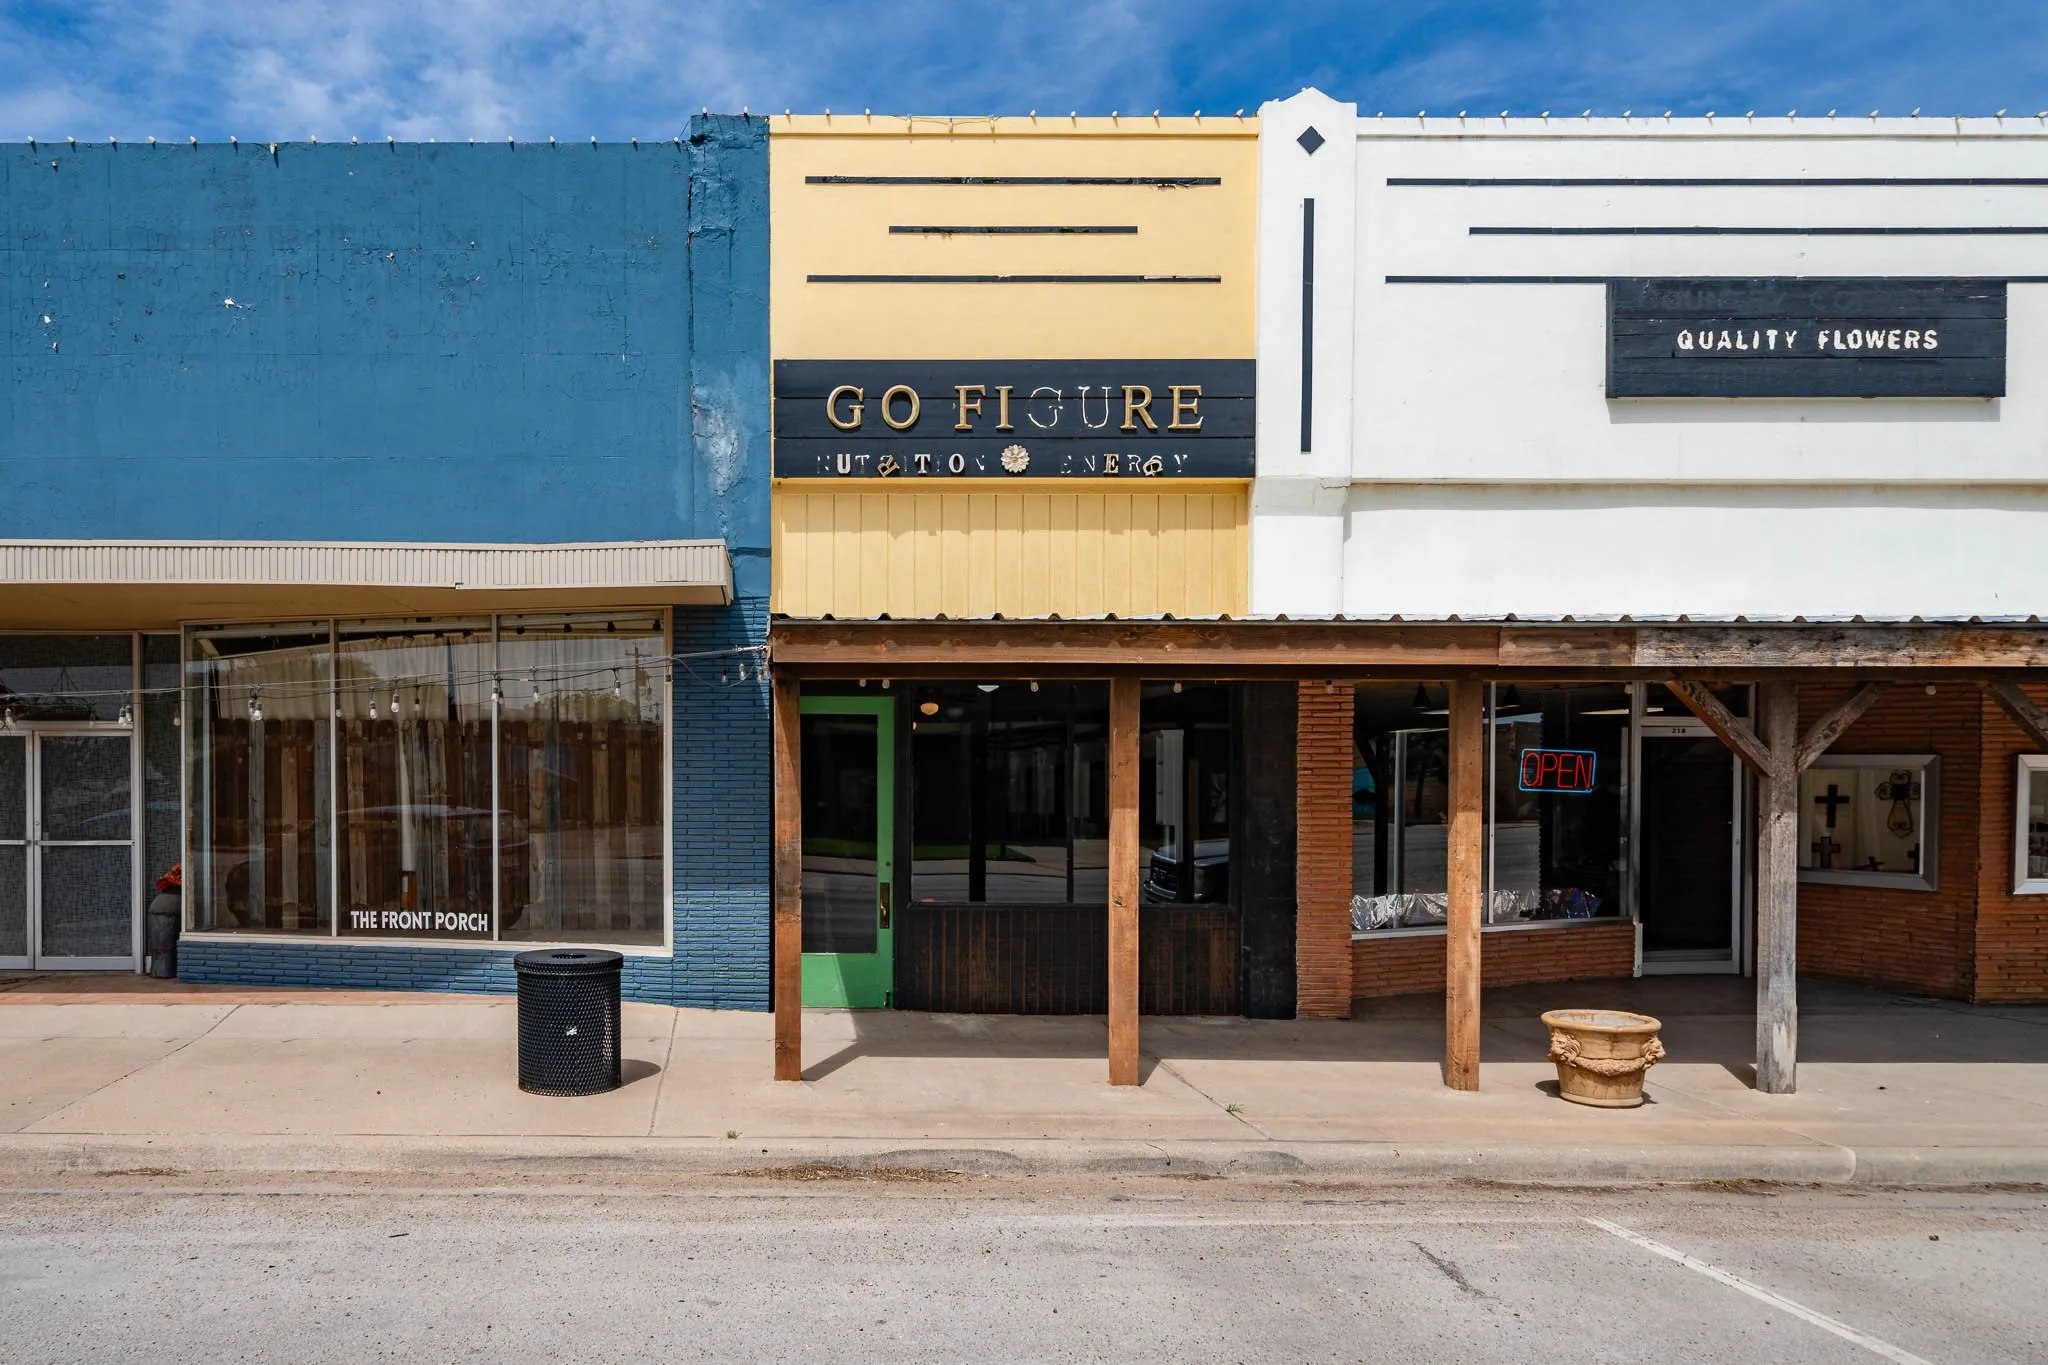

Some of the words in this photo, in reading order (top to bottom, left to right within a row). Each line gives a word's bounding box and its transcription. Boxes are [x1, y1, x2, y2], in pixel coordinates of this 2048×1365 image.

[1677, 329, 1797, 350] QUALITY
[1817, 329, 1939, 350] FLOWERS
[826, 384, 921, 430] GO
[953, 384, 1205, 430] FIGURE
[1522, 751, 1594, 789] OPEN
[350, 910, 378, 929] THE
[381, 911, 432, 930] FRONT
[434, 912, 488, 932] PORCH
